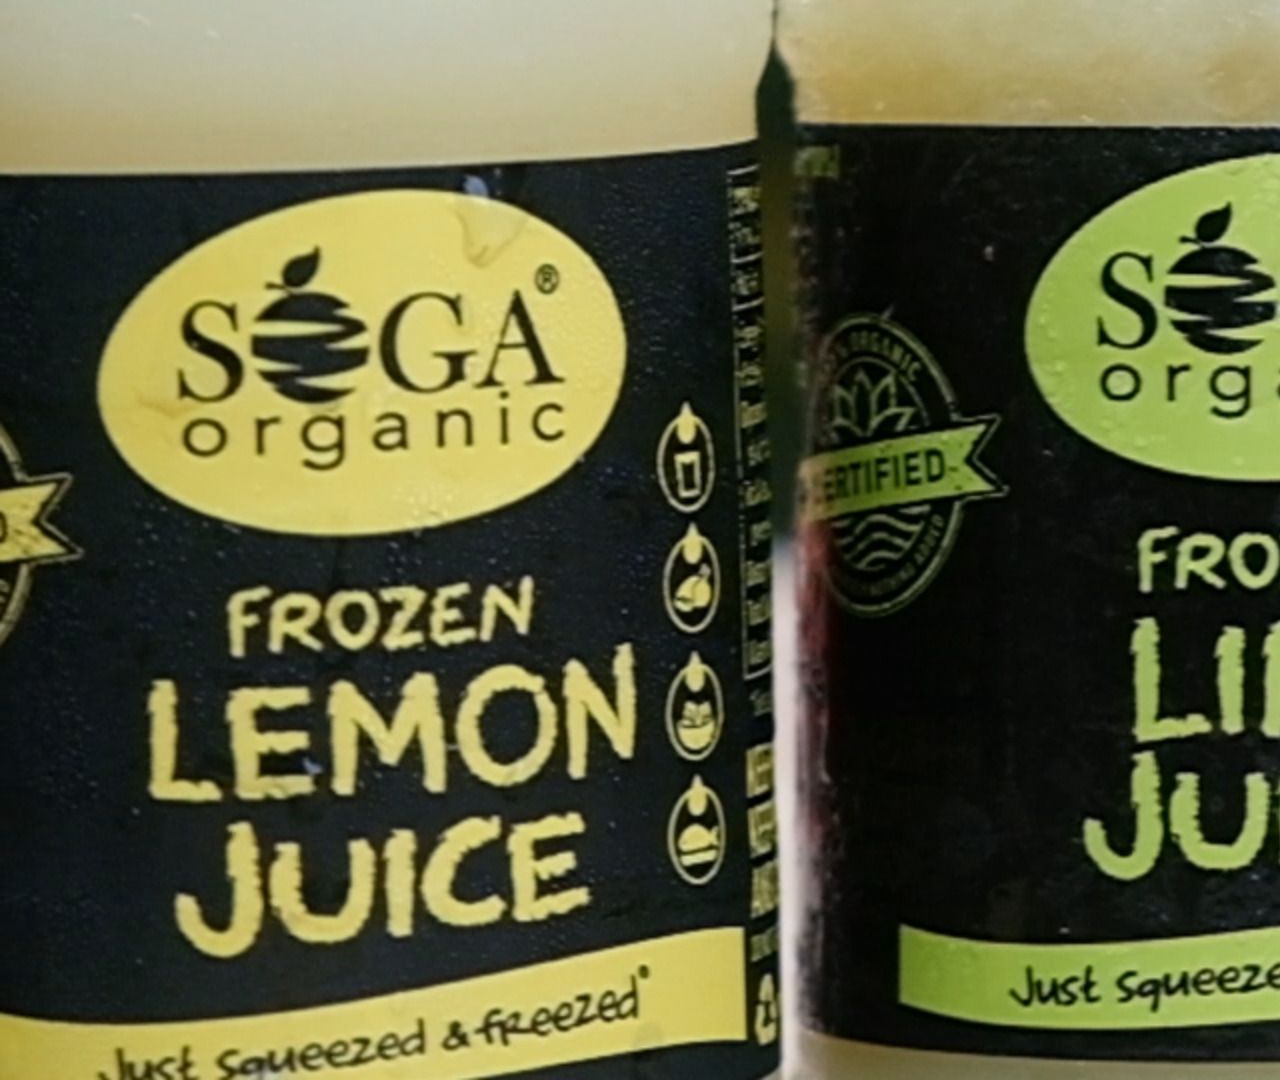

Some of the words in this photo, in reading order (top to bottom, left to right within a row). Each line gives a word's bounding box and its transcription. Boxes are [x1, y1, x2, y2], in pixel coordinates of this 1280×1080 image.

[184, 390, 567, 470] organic
[808, 449, 945, 503] ERTIFIED
[227, 575, 534, 658] FROZEN
[147, 642, 638, 802] LEMON
[174, 810, 592, 960] JUICE
[1008, 964, 1101, 1008] Just
[98, 1046, 200, 1080] Just
[216, 1018, 427, 1080] squeezed
[440, 1022, 471, 1051] &
